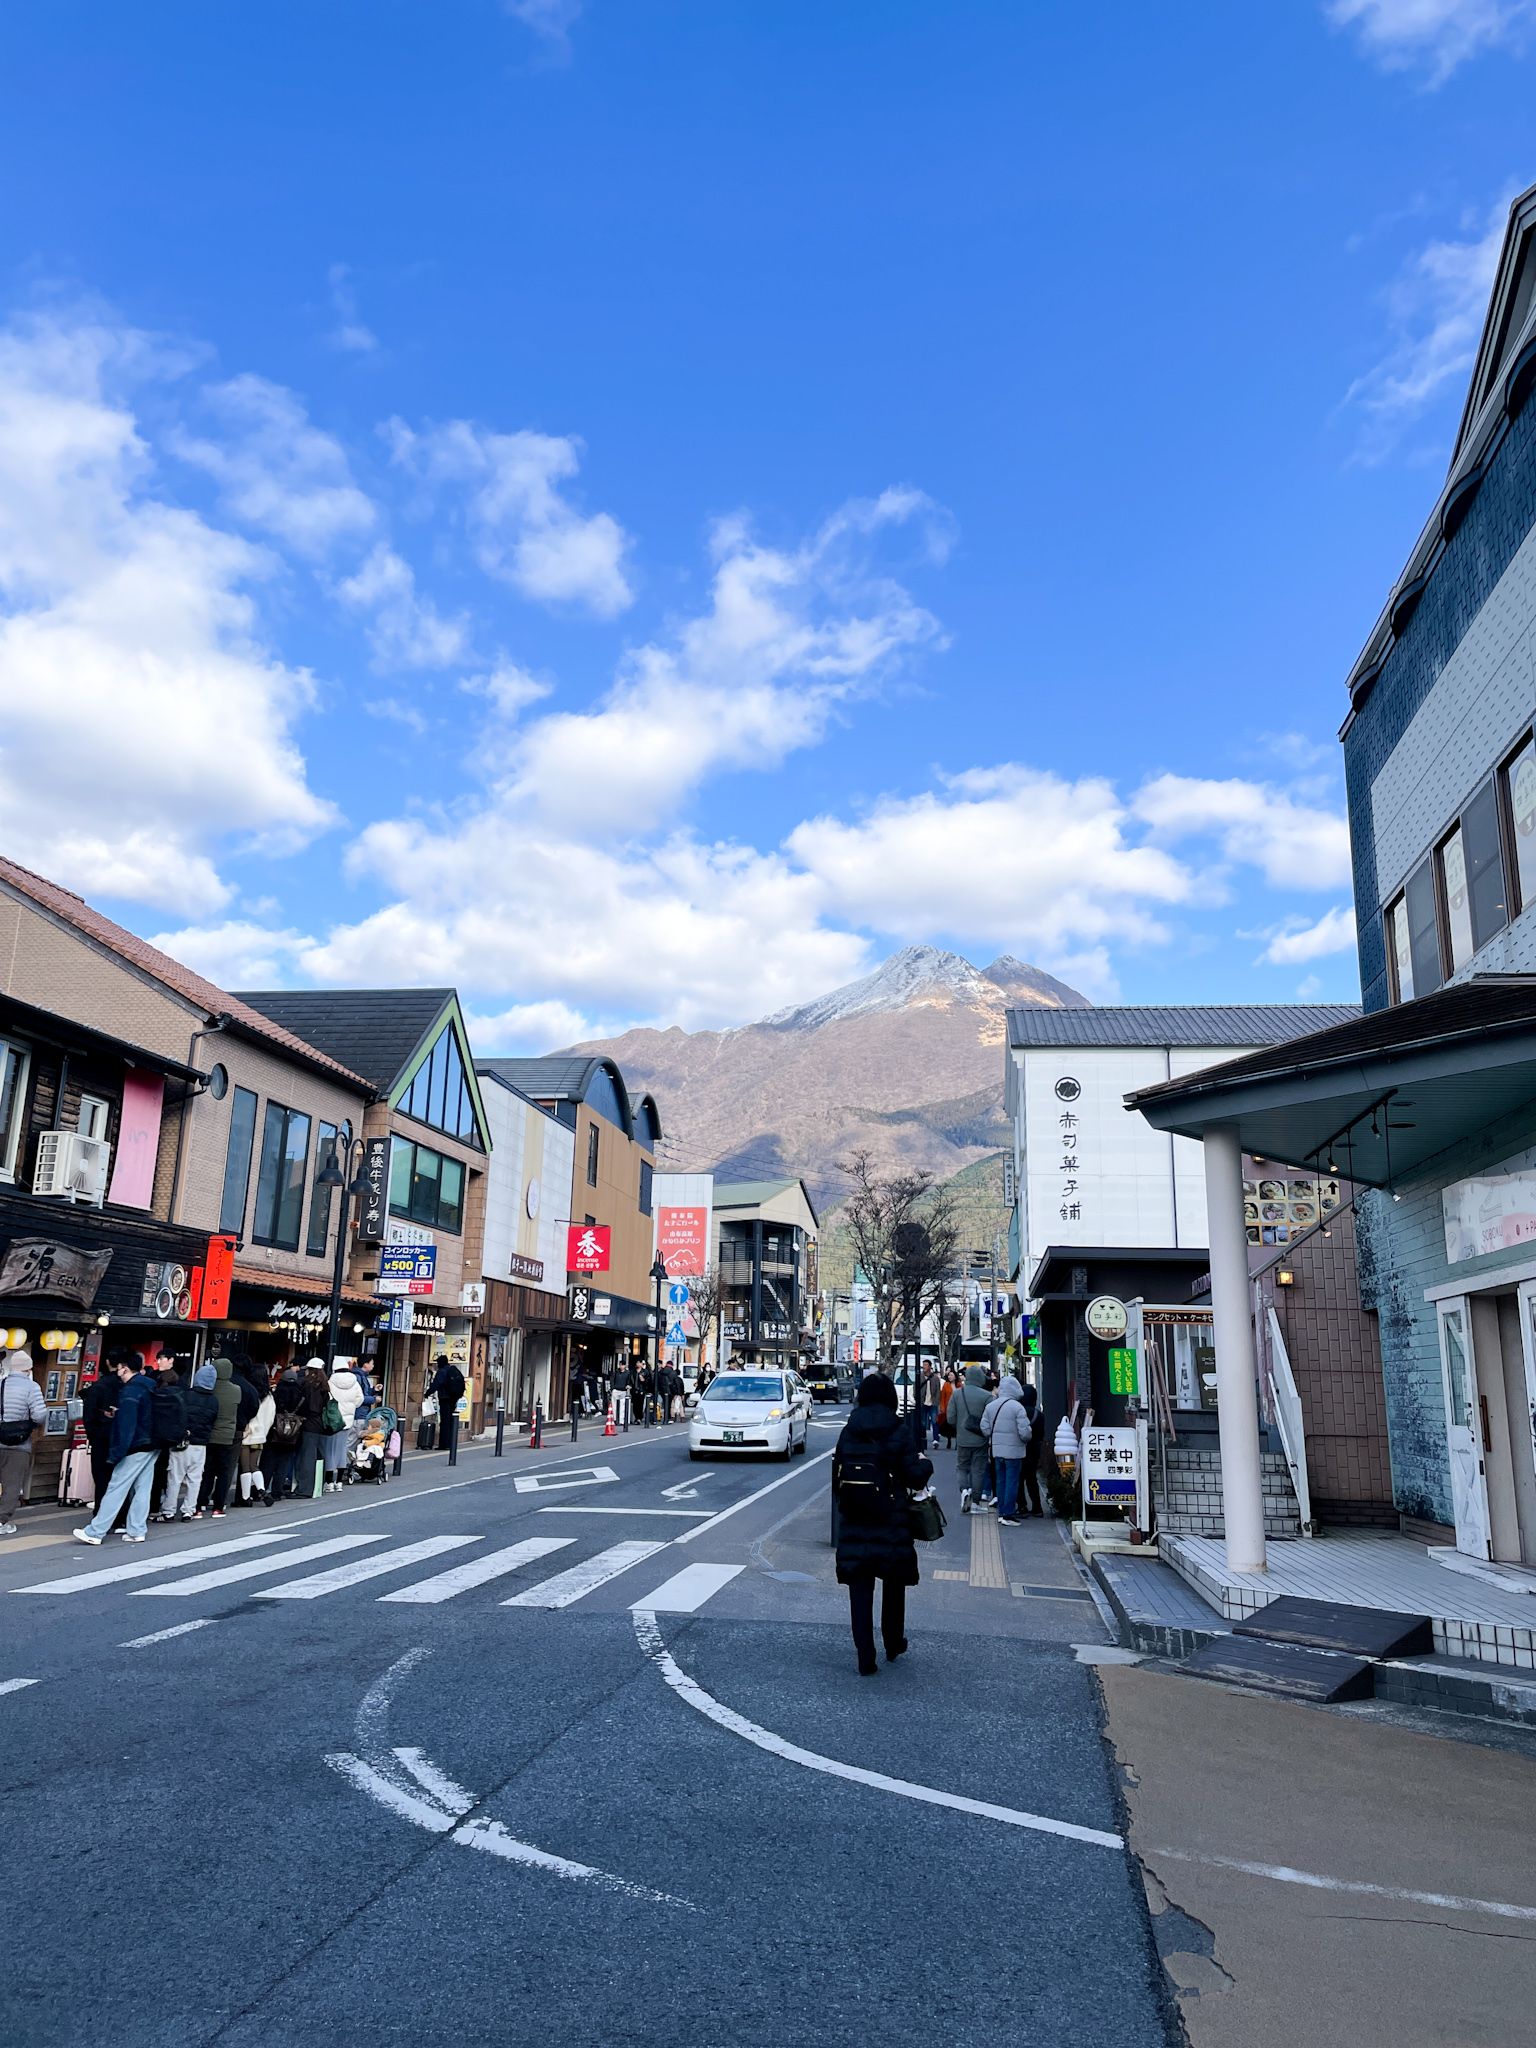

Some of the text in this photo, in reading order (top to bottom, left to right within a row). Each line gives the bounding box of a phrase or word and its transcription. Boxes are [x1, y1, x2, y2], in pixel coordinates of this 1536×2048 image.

[1059, 1111, 1082, 1220] 赤司菓子舗
[365, 1143, 384, 1234] 豊後牛炙り寿し
[576, 1230, 604, 1257] 香
[384, 1261, 414, 1270] ¥500
[1088, 1434, 1105, 1445] 2F
[1088, 1448, 1133, 1462] 営業中
[1108, 1466, 1133, 1474] 四季彩
